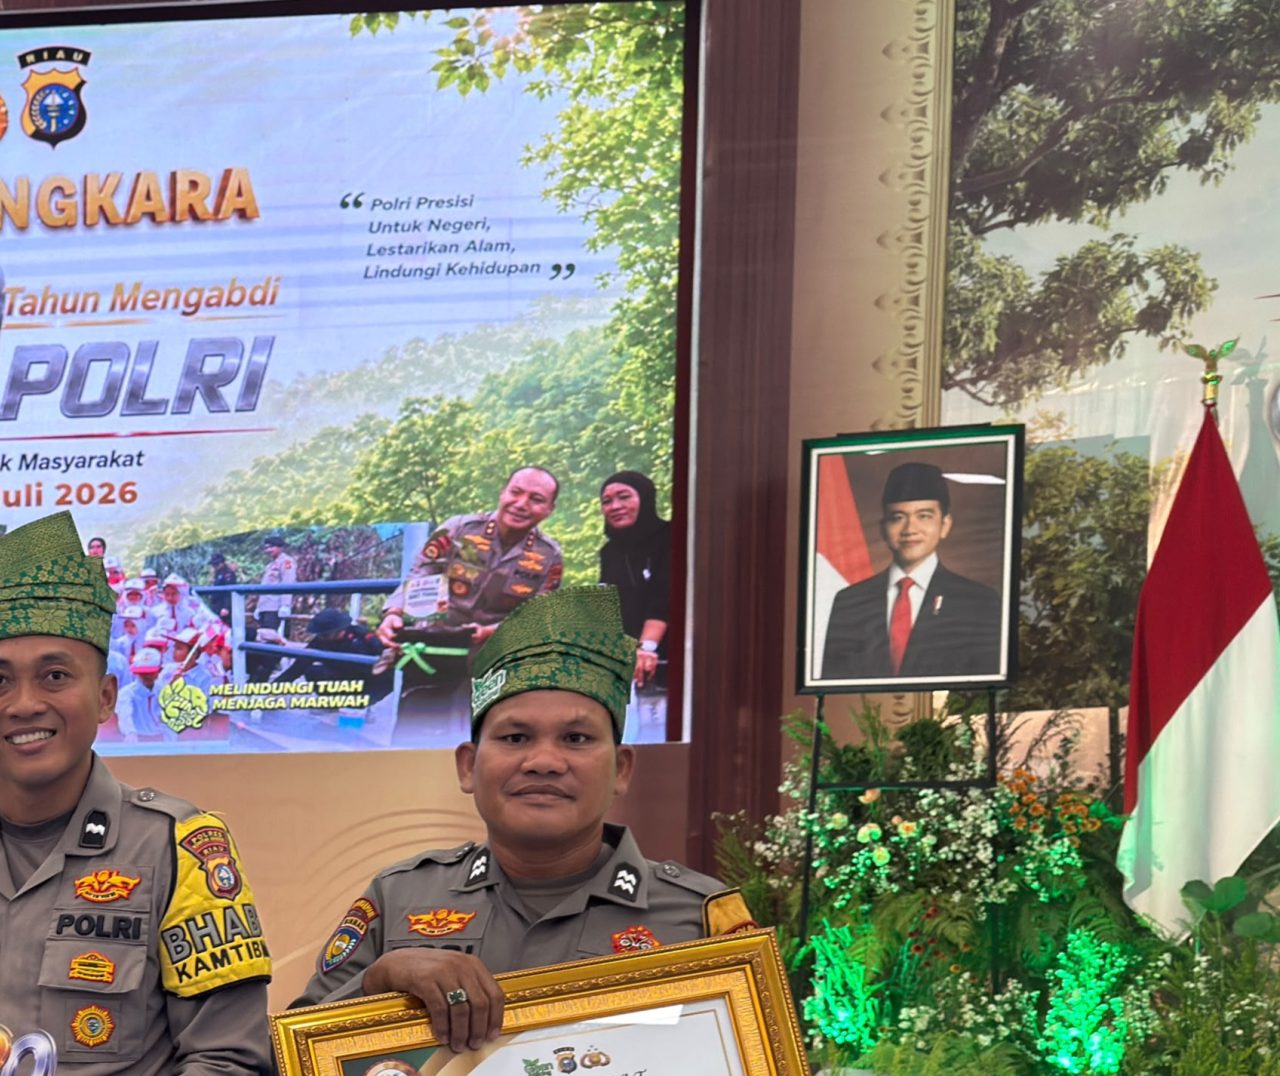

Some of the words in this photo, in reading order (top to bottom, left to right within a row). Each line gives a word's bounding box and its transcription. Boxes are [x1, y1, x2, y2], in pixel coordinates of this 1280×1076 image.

[25, 49, 84, 65] RIAU
[370, 197, 412, 211] Polri
[416, 194, 475, 211] Presisi
[368, 218, 422, 235] Untuk
[427, 216, 491, 235] Negeri,
[366, 241, 460, 257] Lestarikan
[464, 239, 516, 255] Alam,
[363, 262, 442, 280] Lindungi
[445, 260, 541, 277] Kehidupan
[4, 282, 101, 317] Tahun
[108, 276, 282, 322] Mengabdi
[17, 448, 145, 476] Masyarakat
[54, 480, 138, 507] 2026
[208, 681, 315, 696] MELINDUNGI
[316, 679, 365, 694] TUAH
[212, 696, 288, 711] MENJAGA
[289, 694, 370, 709] MARWAH
[55, 913, 142, 941] POLRI
